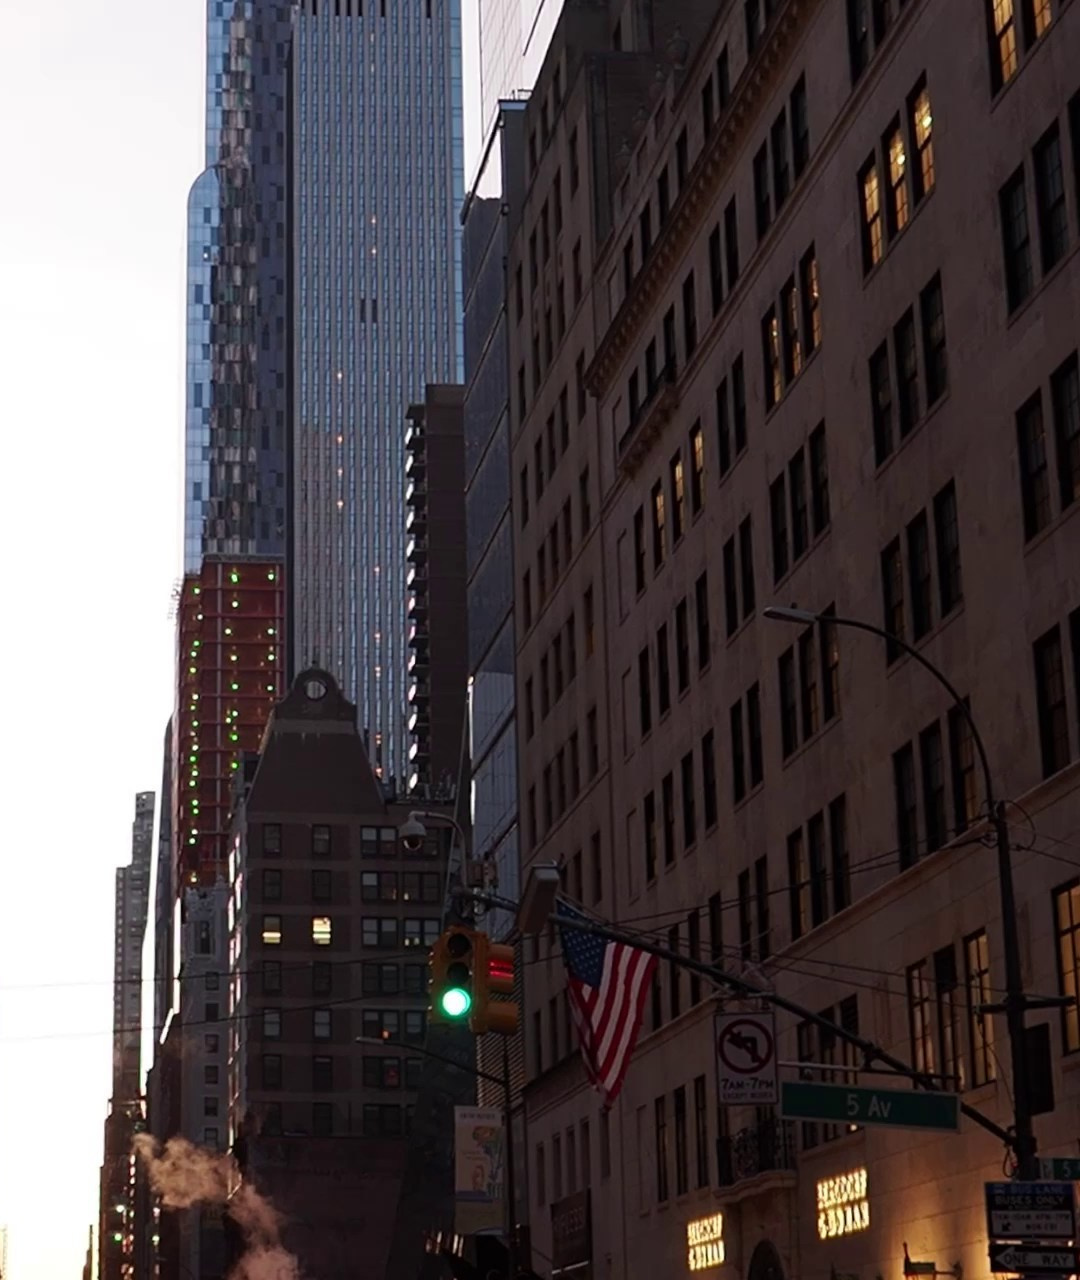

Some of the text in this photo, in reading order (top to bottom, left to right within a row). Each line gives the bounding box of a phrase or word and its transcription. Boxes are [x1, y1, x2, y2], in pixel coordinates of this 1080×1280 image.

[846, 1093, 892, 1118] 5 Av
[1063, 1160, 1071, 1177] 5
[1004, 1252, 1069, 1266] ONE WAY
